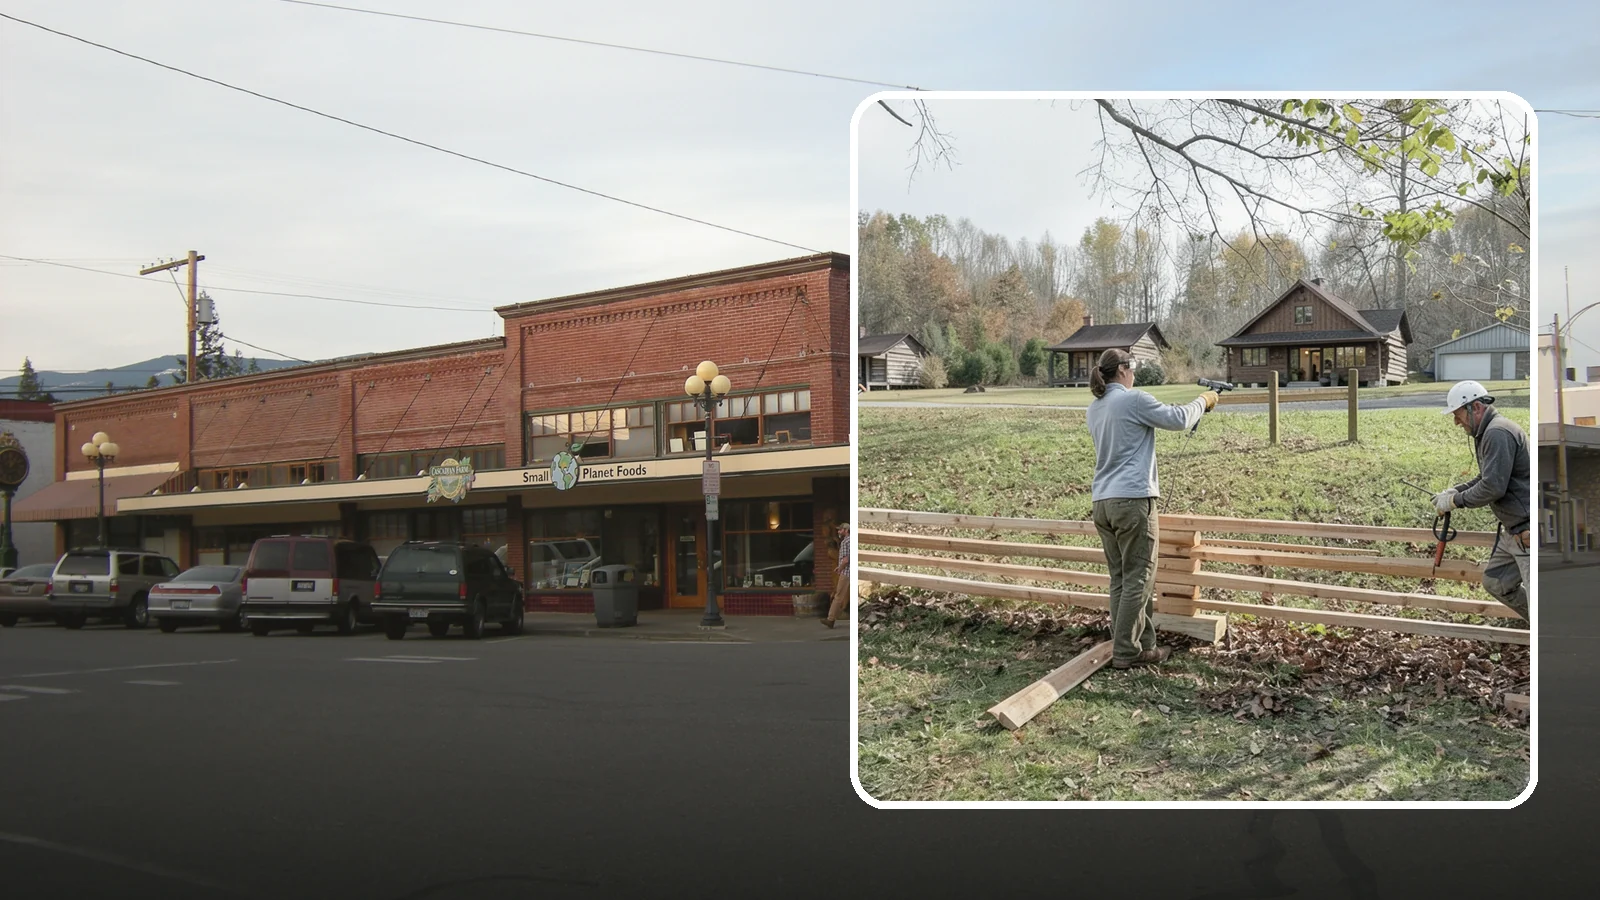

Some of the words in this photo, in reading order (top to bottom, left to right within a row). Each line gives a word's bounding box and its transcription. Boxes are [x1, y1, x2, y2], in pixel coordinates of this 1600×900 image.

[431, 467, 455, 475] CASCADIAN
[456, 466, 469, 474] FARM
[523, 471, 549, 483] Small
[583, 468, 614, 479] Planet
[617, 464, 647, 477] Foods
